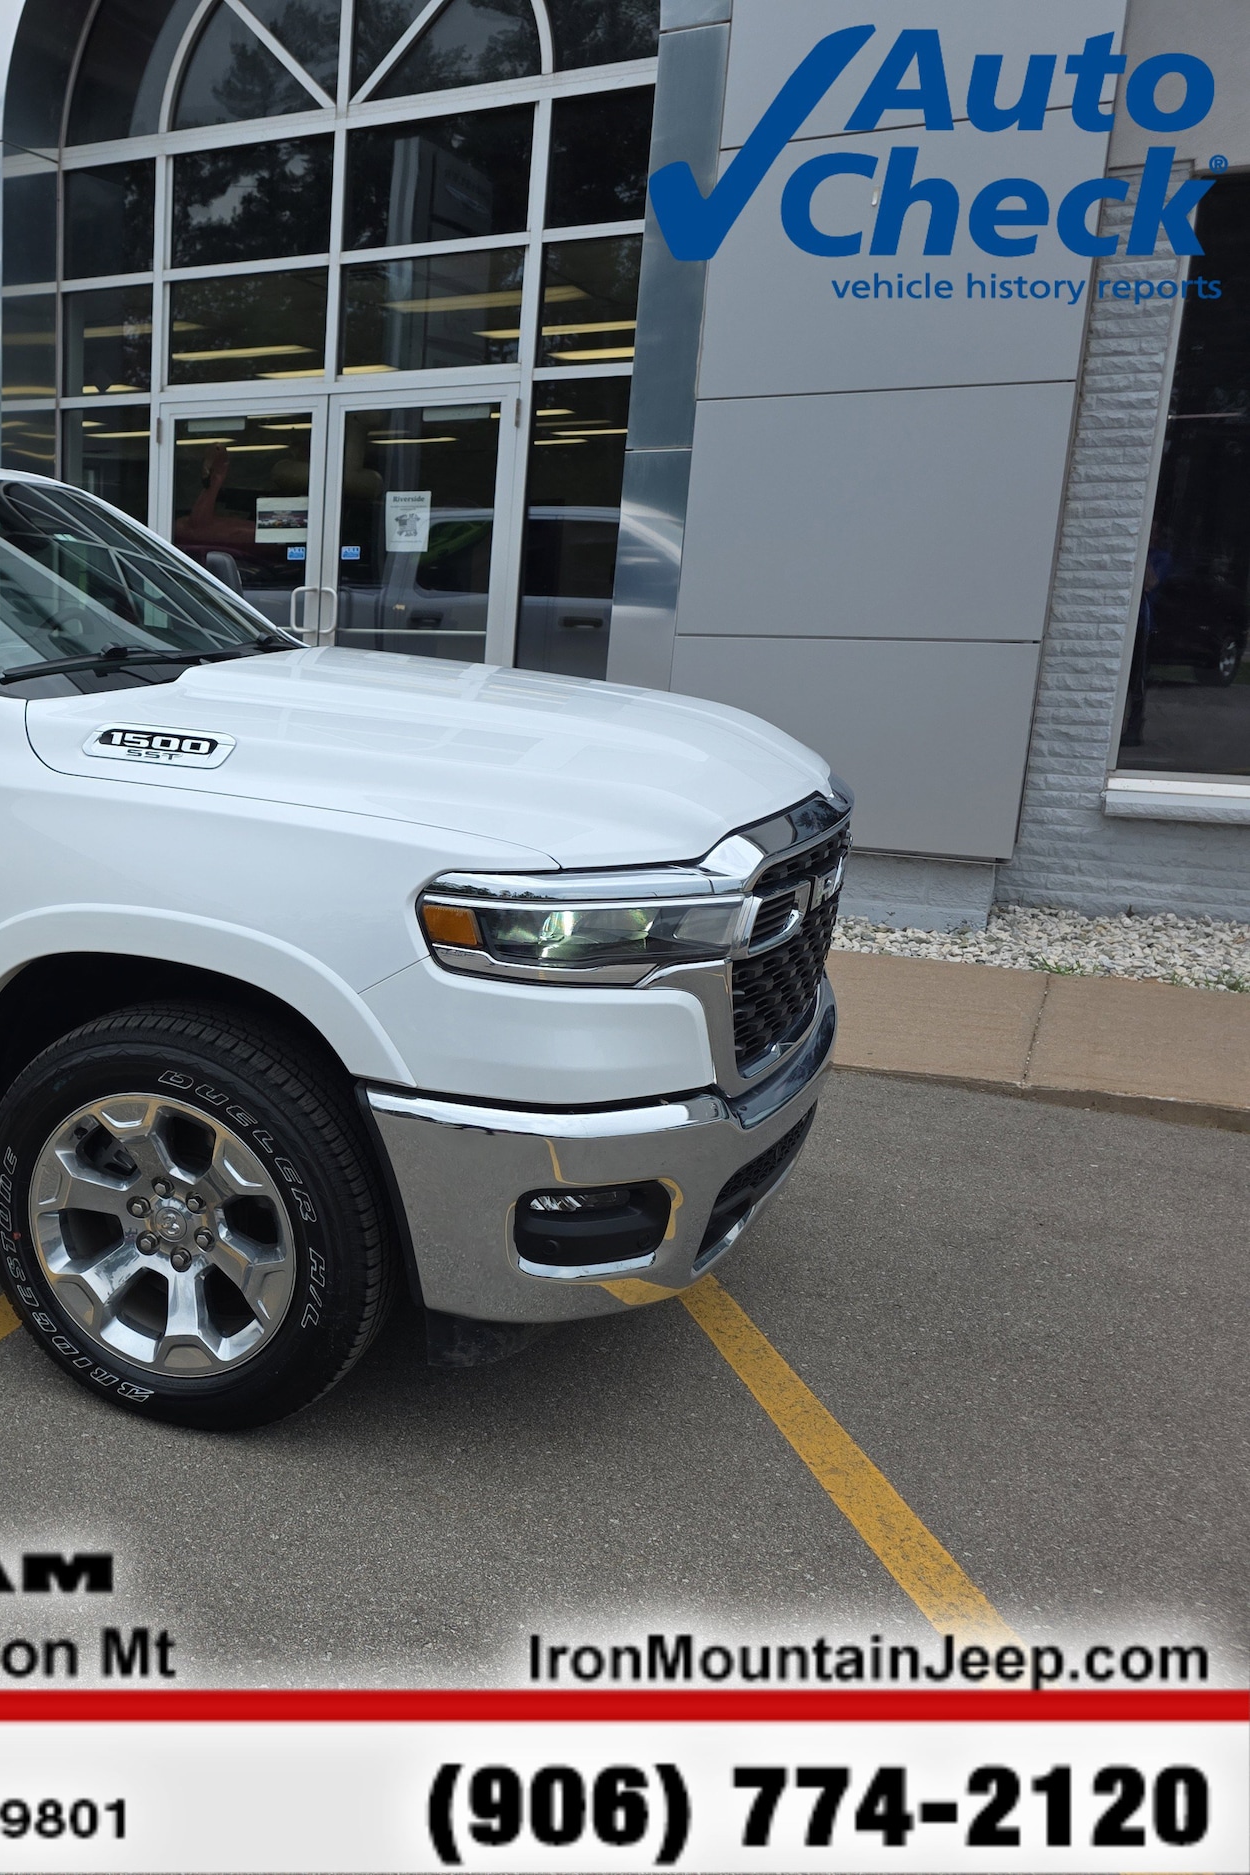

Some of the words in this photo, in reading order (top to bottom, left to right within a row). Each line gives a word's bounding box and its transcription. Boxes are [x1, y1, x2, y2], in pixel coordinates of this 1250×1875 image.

[111, 731, 210, 754] 1500
[126, 749, 179, 761] SST
[158, 1069, 317, 1224] DUELER
